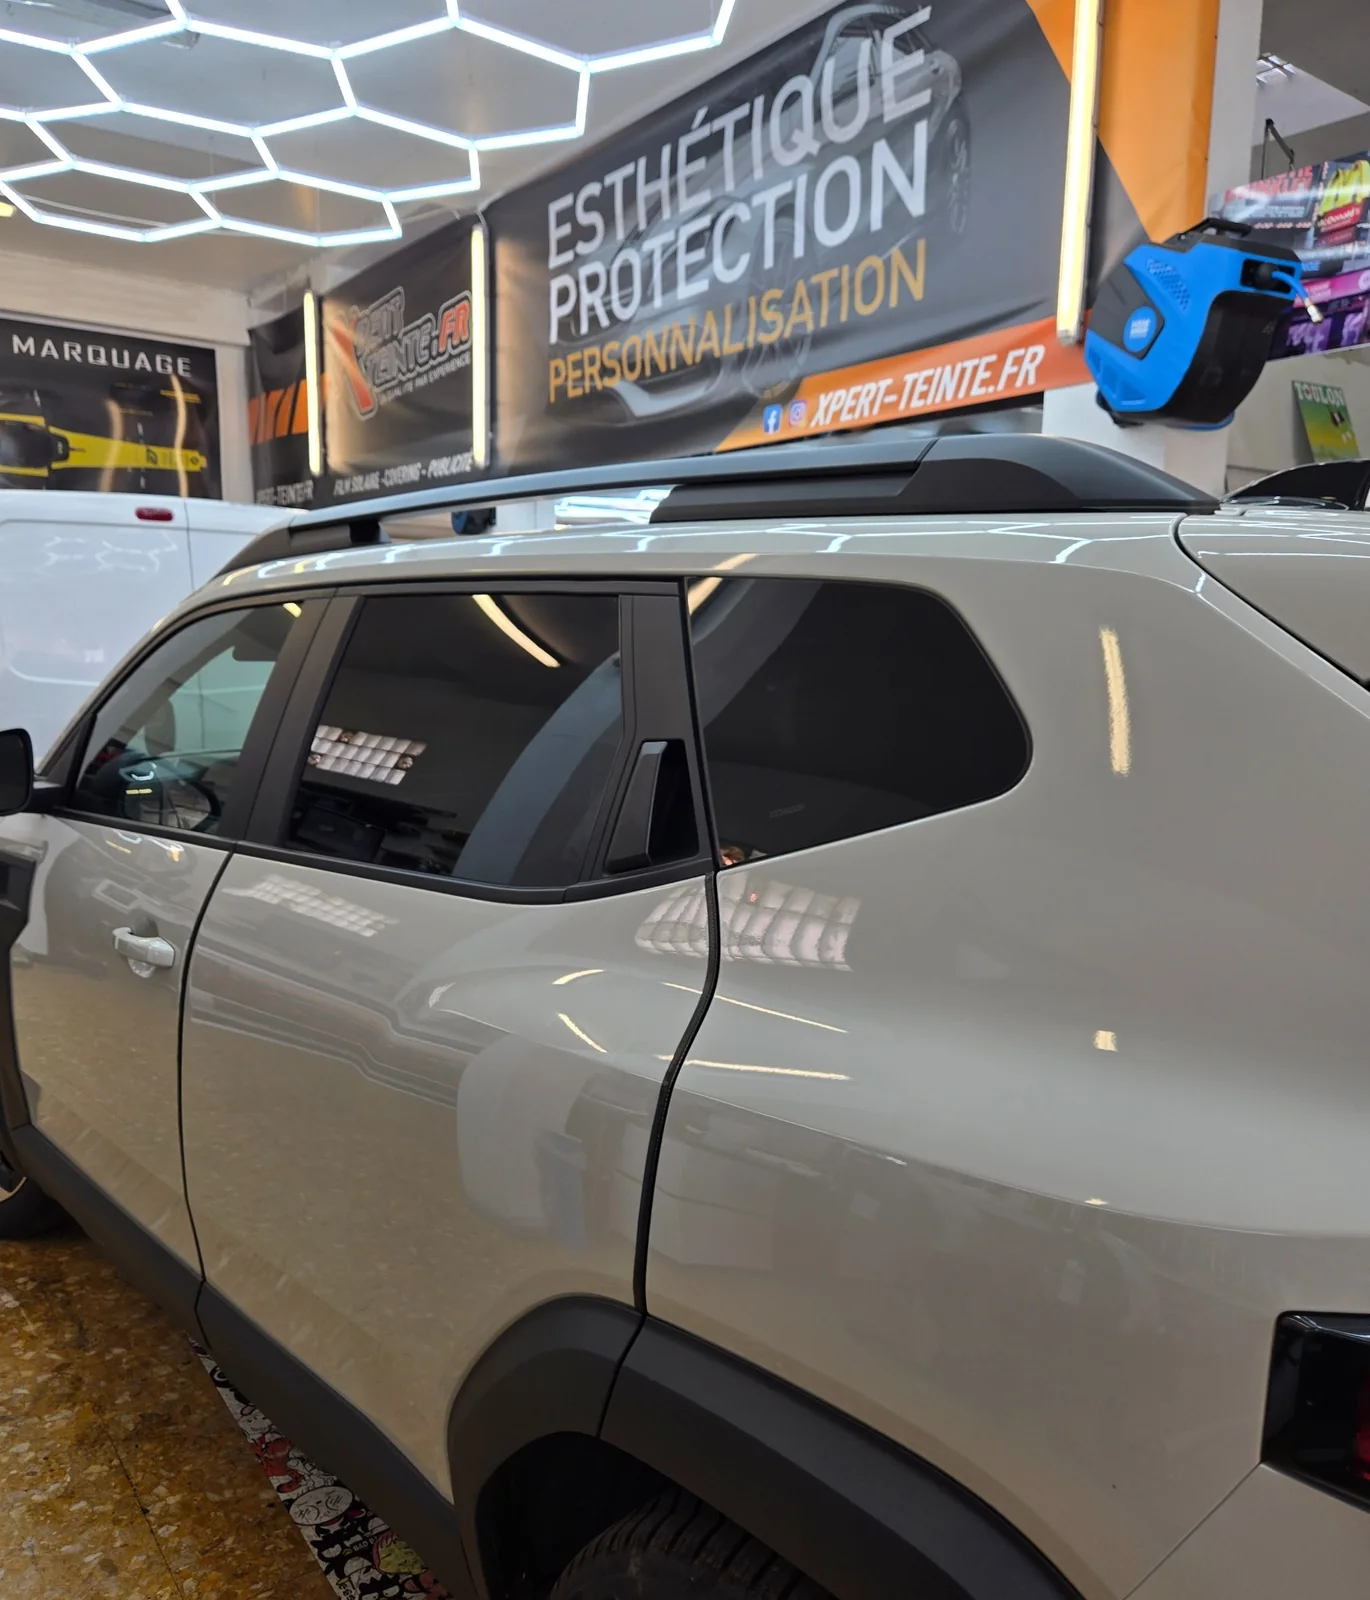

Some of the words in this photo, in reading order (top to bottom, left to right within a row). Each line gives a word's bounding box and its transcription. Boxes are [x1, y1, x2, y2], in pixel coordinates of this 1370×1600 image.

[548, 6, 931, 269] ESTHÉTIQUE
[549, 120, 928, 344] PROTECTION
[12, 334, 191, 378] MARQUAGE
[549, 238, 926, 403] PERSONNALISATION
[810, 344, 1045, 429] XPERT-TEINTE.FR
